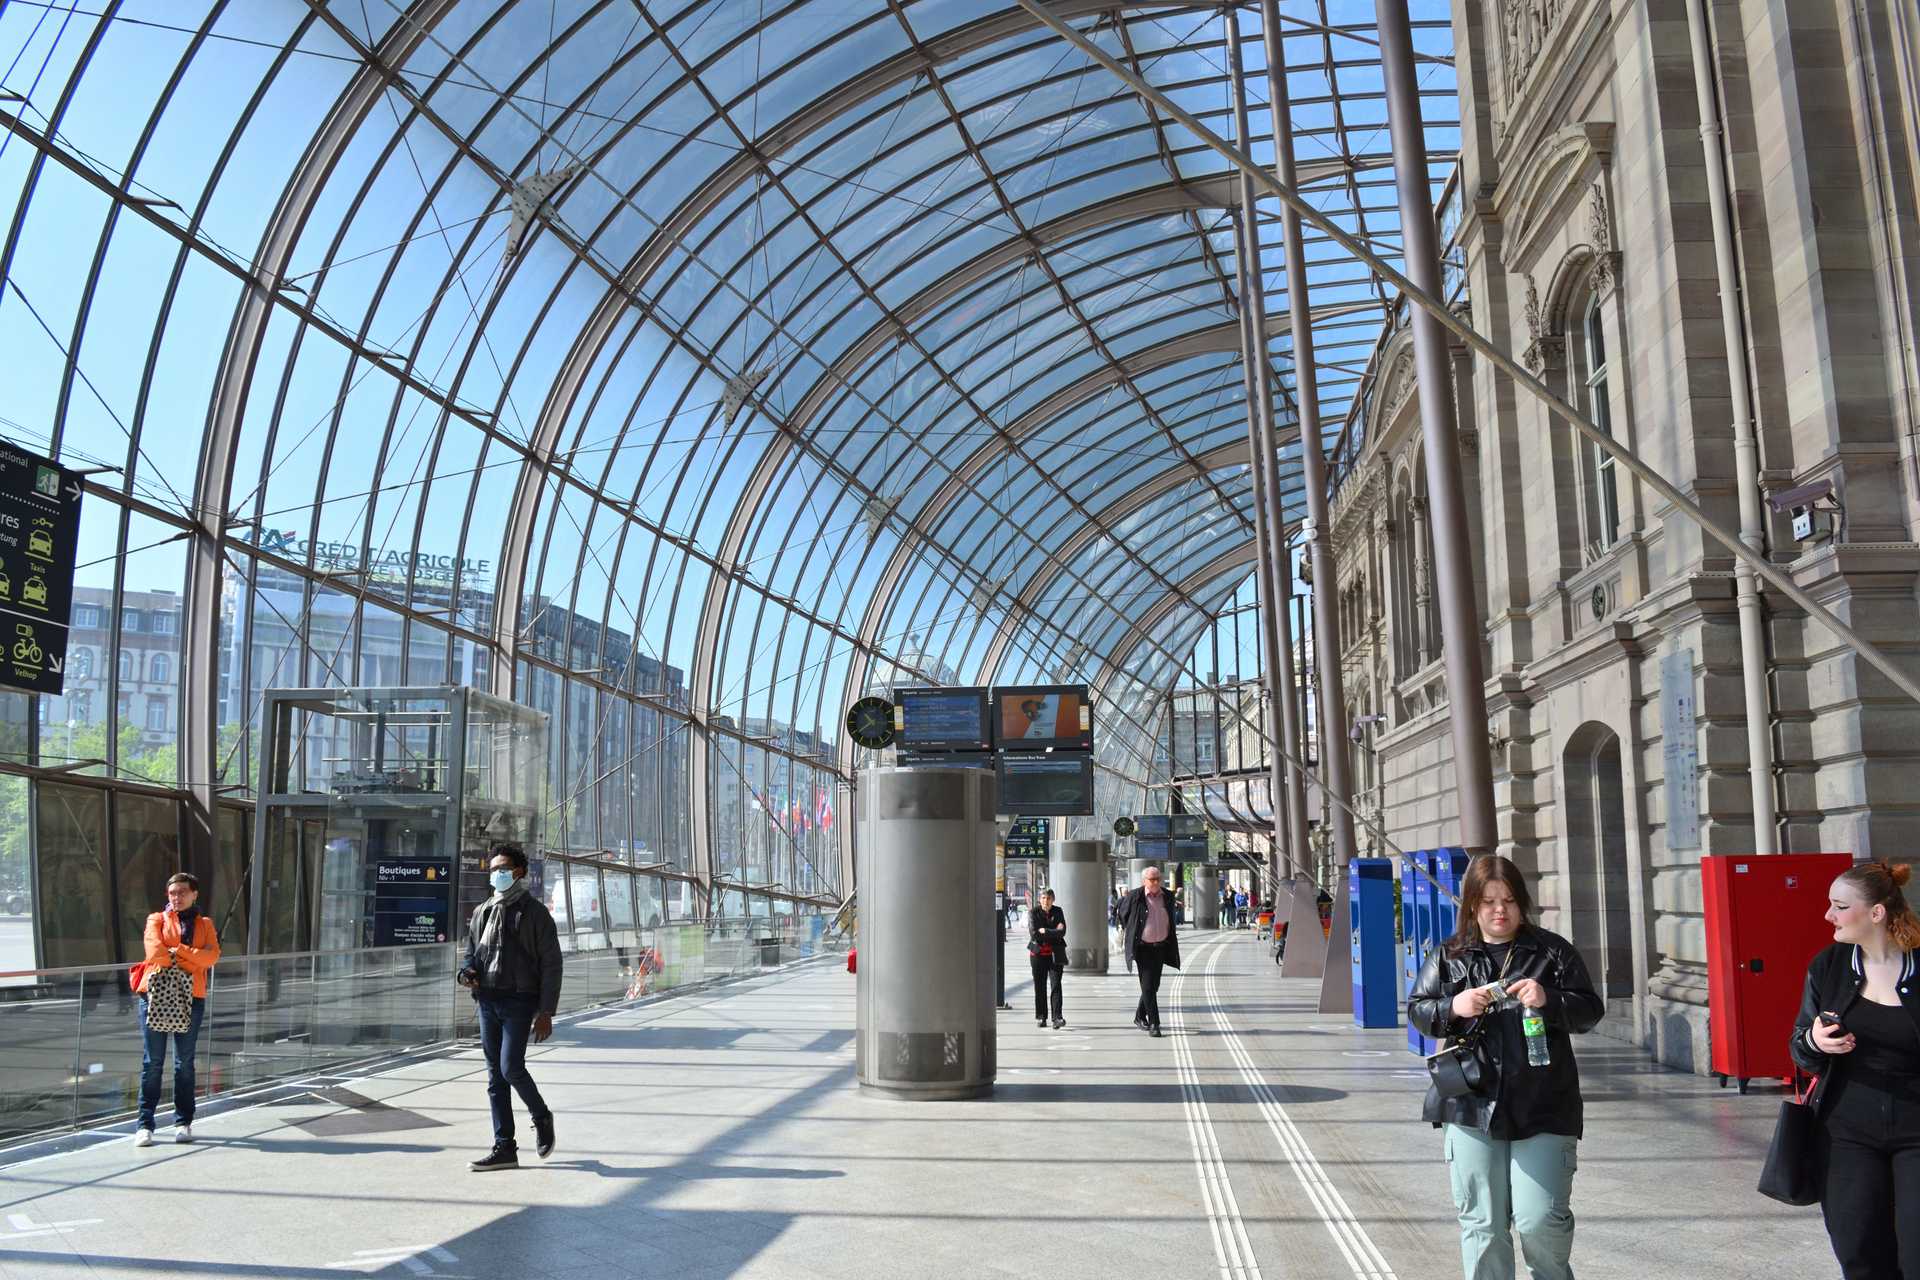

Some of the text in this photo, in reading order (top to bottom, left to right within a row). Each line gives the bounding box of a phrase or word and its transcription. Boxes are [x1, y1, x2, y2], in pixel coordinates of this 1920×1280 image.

[1, 513, 19, 529] res
[298, 540, 377, 560] CRÉDT
[379, 866, 421, 875] Boutiques
